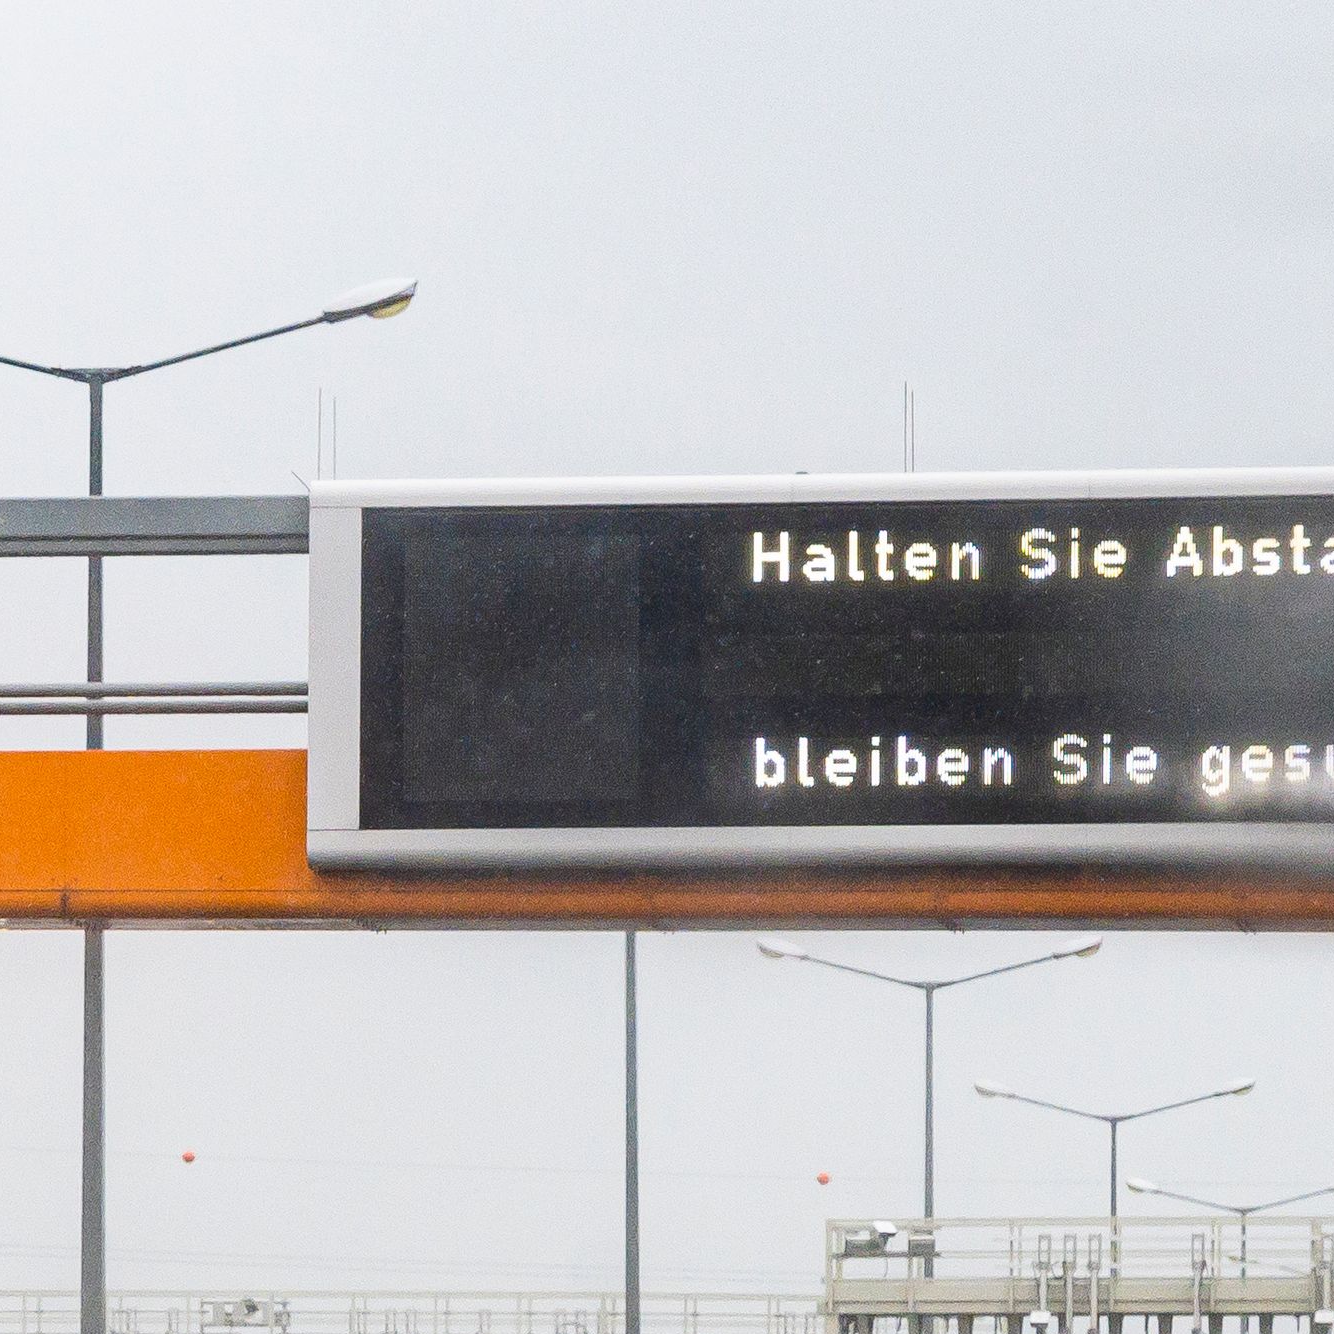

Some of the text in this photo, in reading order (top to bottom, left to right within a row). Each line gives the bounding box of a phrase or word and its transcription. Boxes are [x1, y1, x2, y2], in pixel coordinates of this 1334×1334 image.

[752, 530, 981, 583] Halten
[1021, 527, 1127, 580] Sie
[755, 734, 1013, 788] bleiben
[1053, 733, 1158, 785] Sie
